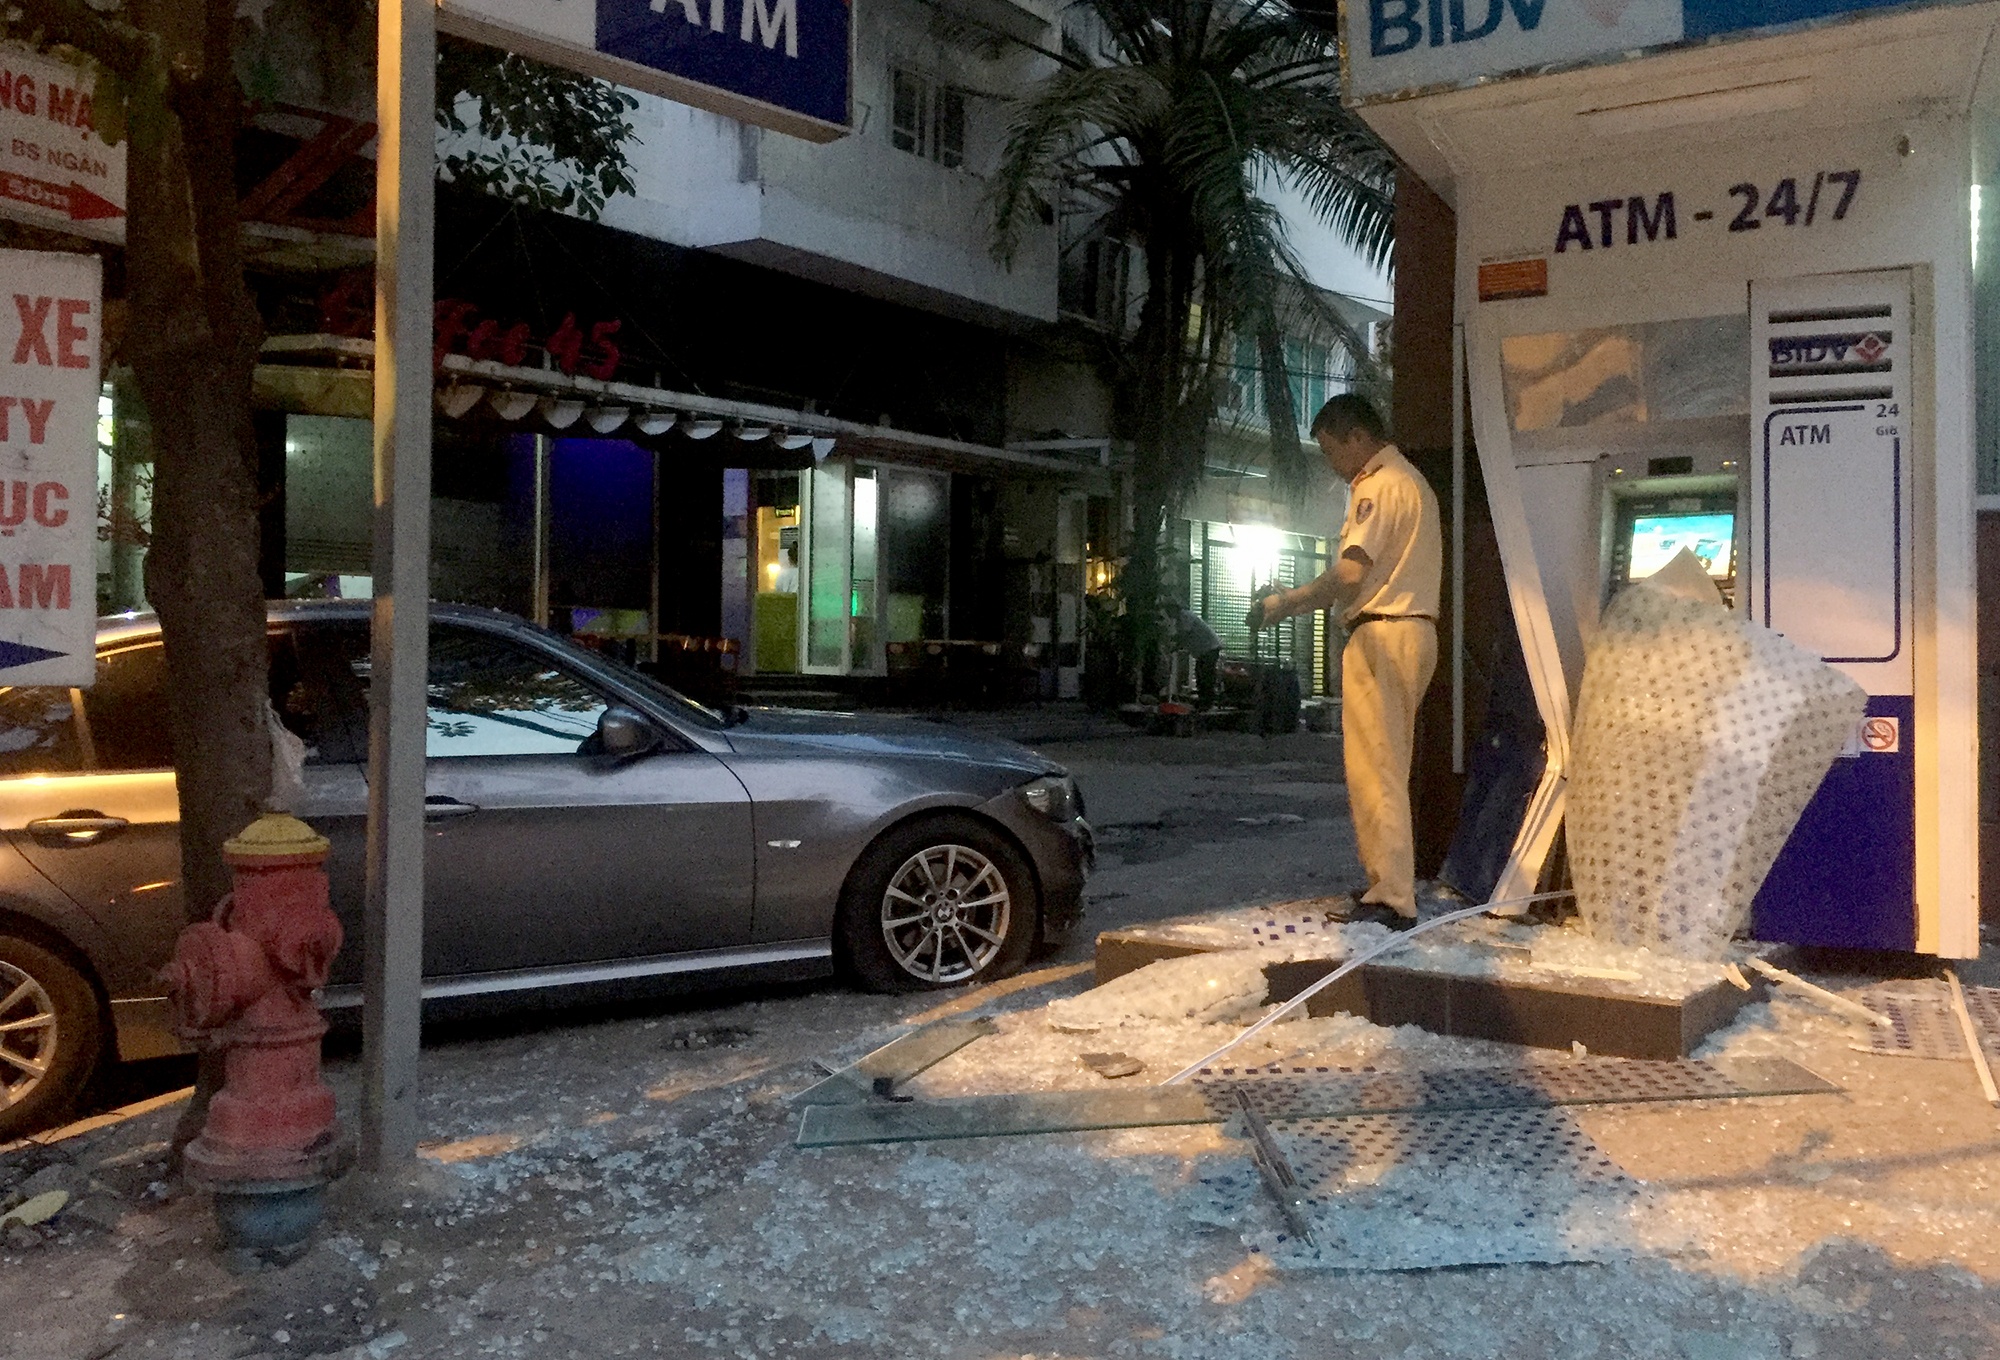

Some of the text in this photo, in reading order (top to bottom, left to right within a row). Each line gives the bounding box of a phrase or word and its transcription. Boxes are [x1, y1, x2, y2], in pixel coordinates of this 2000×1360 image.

[1370, 0, 1550, 58] BIDV
[1554, 169, 1861, 253] ATM - 24/7
[13, 294, 91, 369] XE
[547, 311, 622, 380] 45
[1770, 336, 1850, 364] BIDV
[1780, 424, 1831, 446] ATM
[1876, 403, 1900, 418] 24
